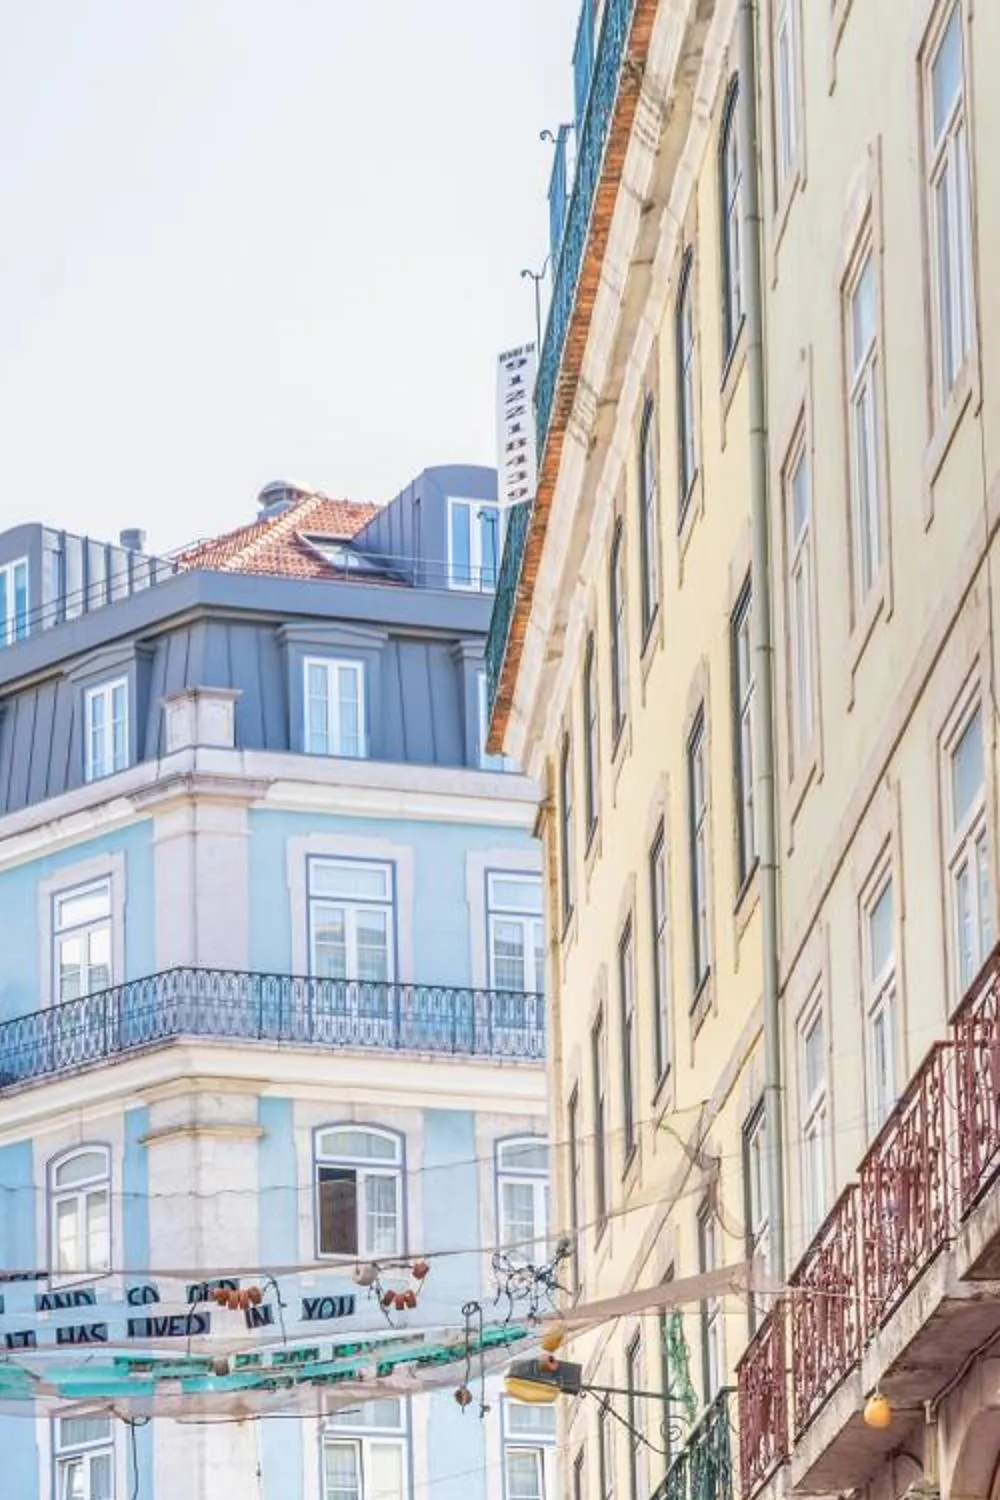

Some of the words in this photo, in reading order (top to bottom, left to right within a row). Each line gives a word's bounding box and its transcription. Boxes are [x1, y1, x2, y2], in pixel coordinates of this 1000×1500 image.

[35, 1288, 95, 1311] AND
[126, 1285, 160, 1307] SO
[5, 1330, 36, 1349] IT
[56, 1323, 107, 1344] HAS
[127, 1312, 210, 1337] LIVED
[245, 1303, 274, 1328] IN
[302, 1294, 355, 1320] YOU
